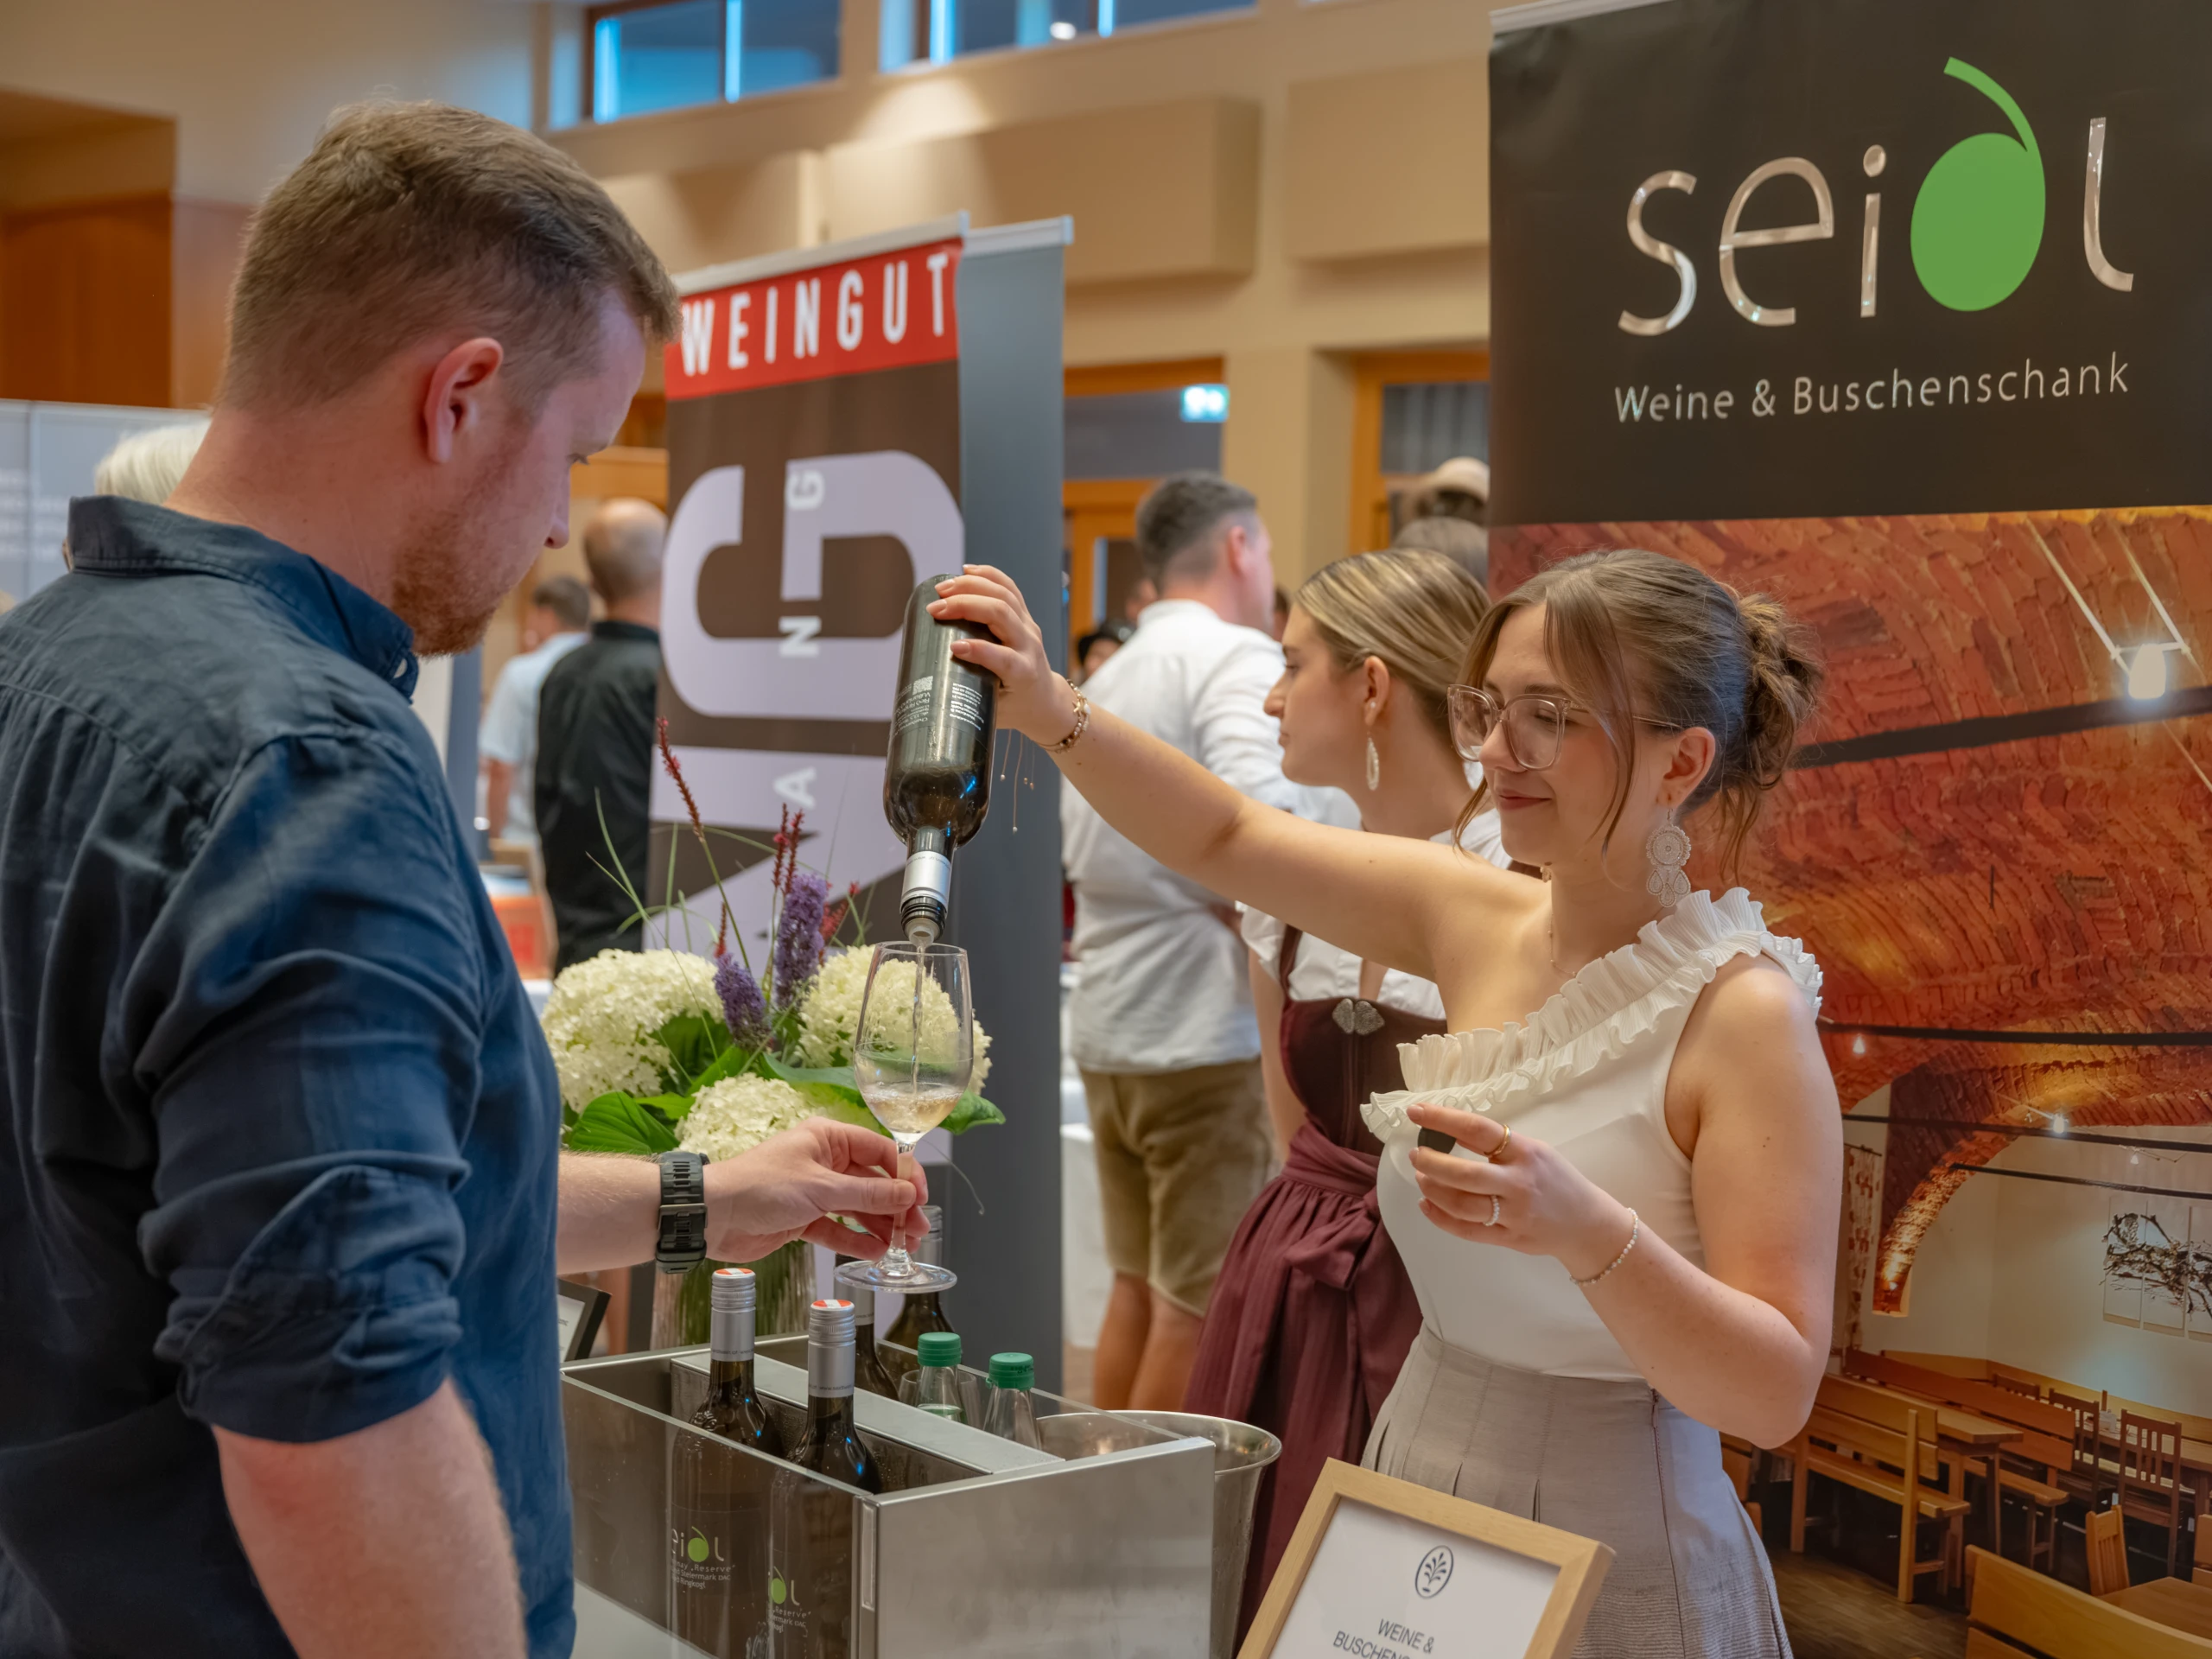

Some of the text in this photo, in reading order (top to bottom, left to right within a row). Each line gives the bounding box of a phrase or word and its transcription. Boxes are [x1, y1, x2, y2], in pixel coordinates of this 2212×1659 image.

[1618, 56, 2134, 336] seidl
[681, 252, 949, 377] WEINGUT
[1614, 351, 2130, 423] Weine & Buschenschank
[1377, 1618, 1434, 1654] WEINE &
